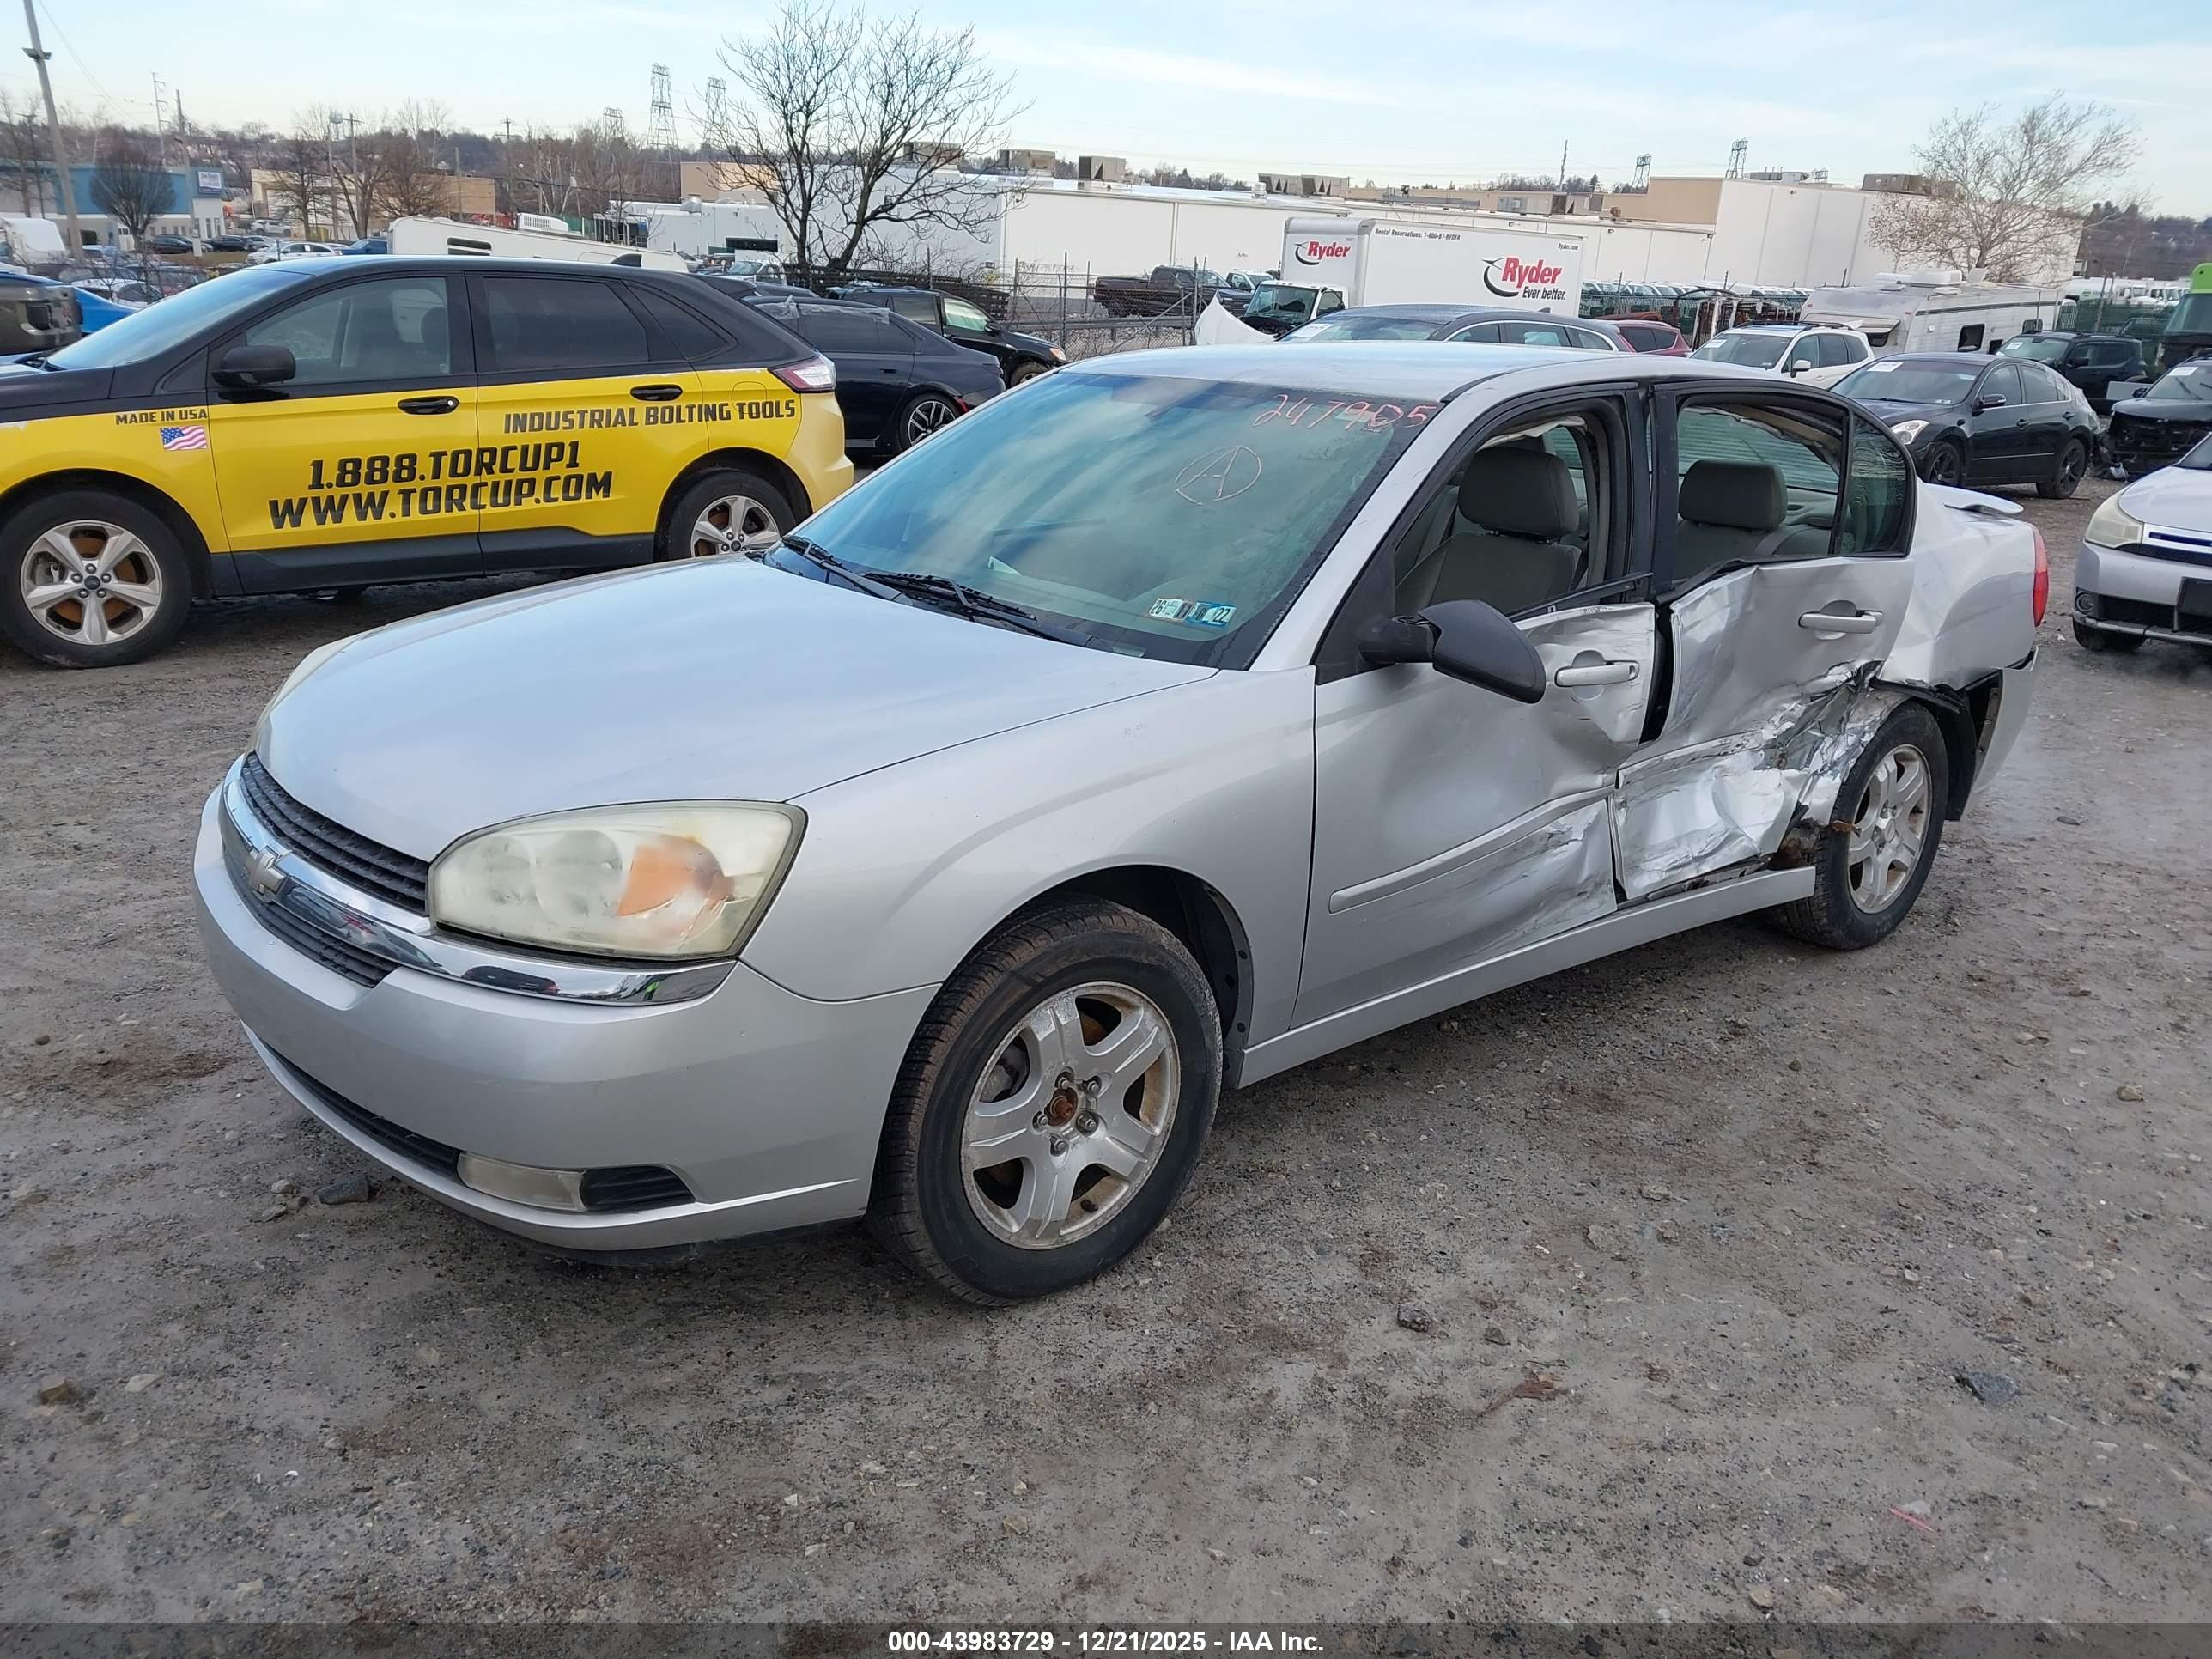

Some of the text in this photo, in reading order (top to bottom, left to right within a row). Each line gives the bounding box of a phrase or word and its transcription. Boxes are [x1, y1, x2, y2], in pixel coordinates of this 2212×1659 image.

[1307, 240, 1351, 260] Ryder
[1502, 257, 1562, 289] Ryder
[1522, 286, 1566, 301] Ever better.
[115, 408, 208, 425] MADE IN USA
[504, 399, 795, 434] INDUSTRIAL BOLTING TOOLS
[307, 440, 580, 490] 1.888.TORCUP1
[268, 471, 612, 530] WWW.TORCUP.COM
[1213, 608, 1230, 623] 22
